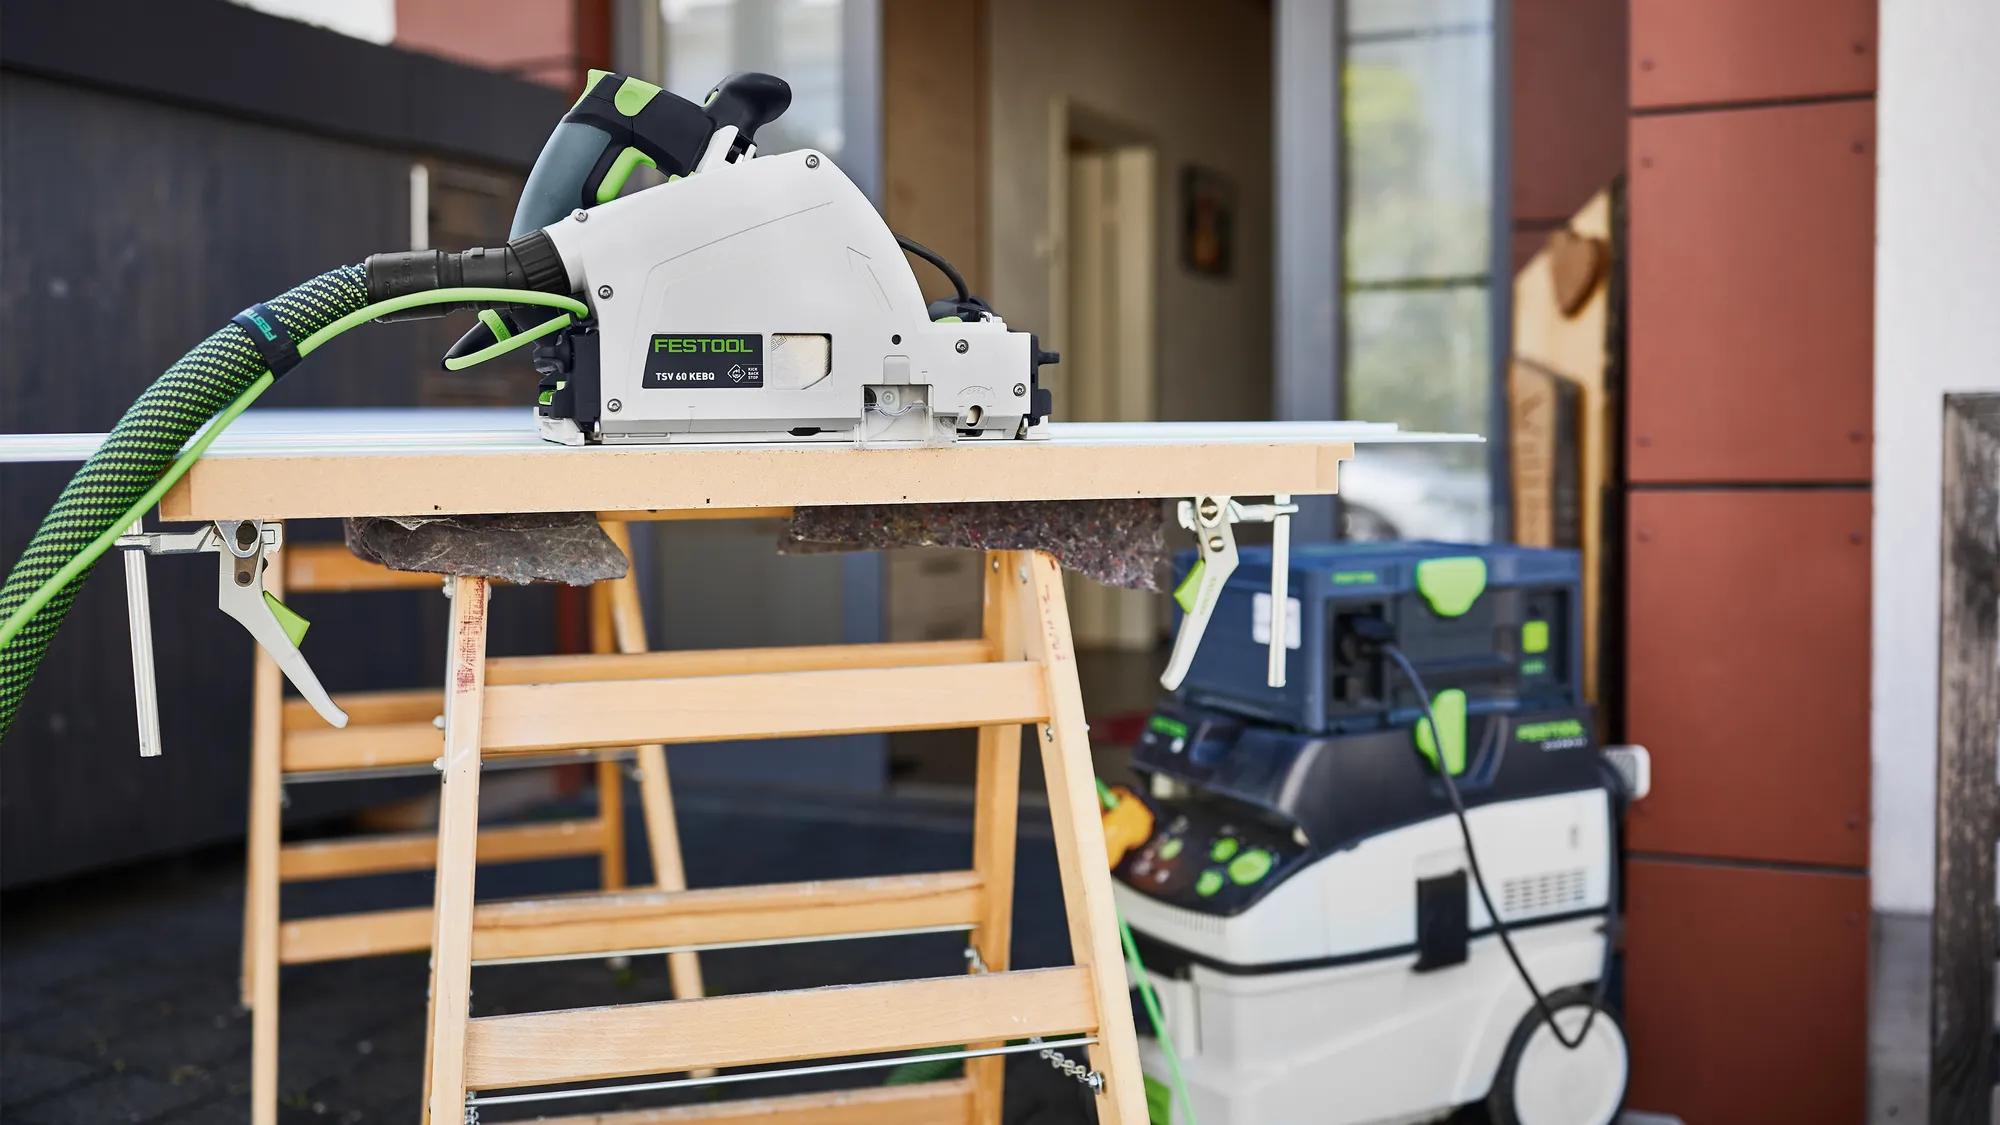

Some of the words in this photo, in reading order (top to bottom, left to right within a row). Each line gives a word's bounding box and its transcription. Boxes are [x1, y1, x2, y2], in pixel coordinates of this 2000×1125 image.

[654, 338, 753, 353] FESTOOL
[656, 372, 674, 381] TSV
[675, 372, 687, 381] 60
[689, 372, 715, 381] KEBQ
